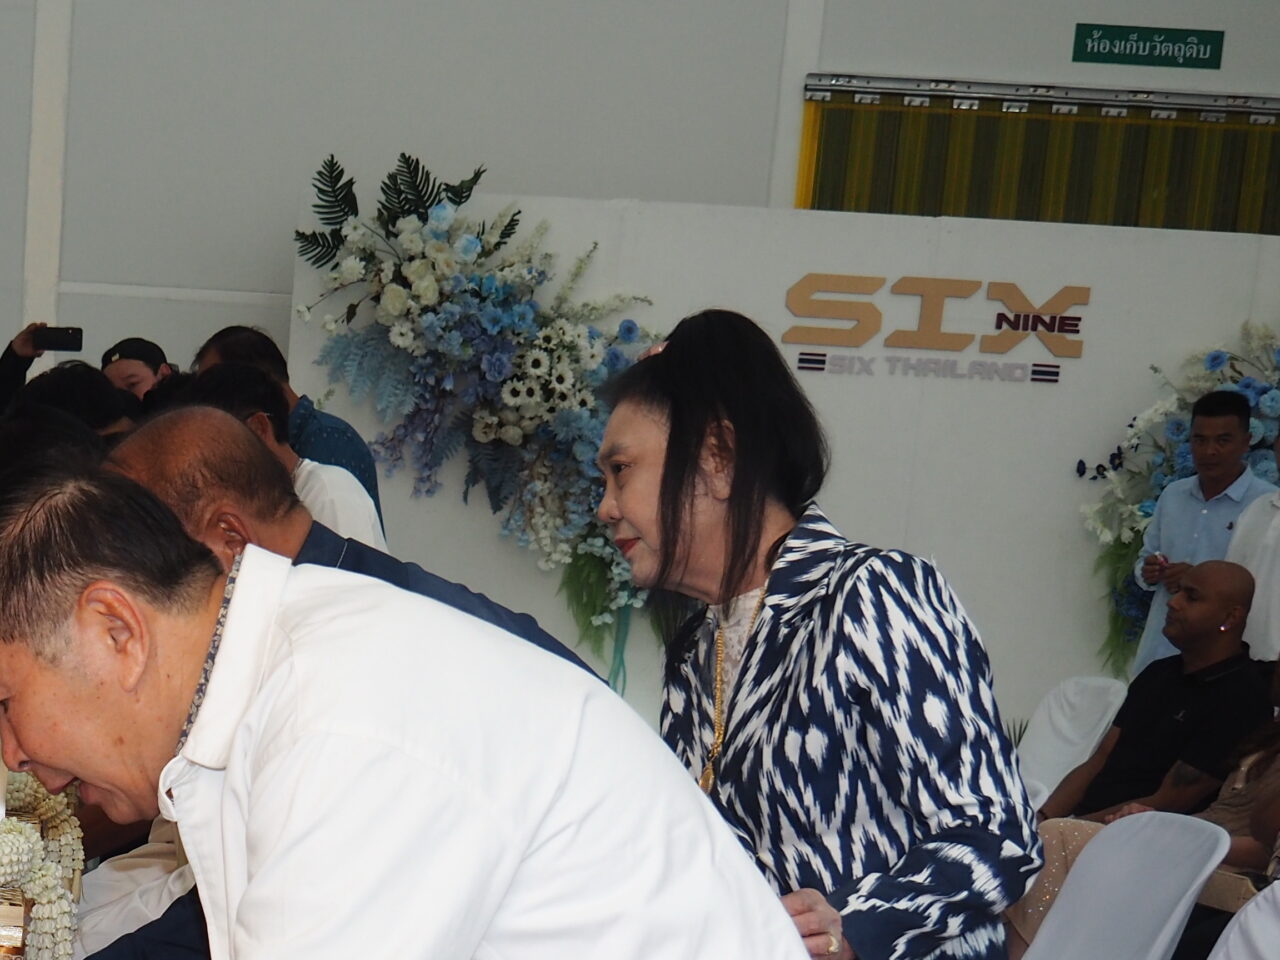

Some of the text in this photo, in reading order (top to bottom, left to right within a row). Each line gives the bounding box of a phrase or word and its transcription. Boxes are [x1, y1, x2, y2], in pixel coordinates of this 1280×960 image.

[1085, 30, 1211, 64] ห้องเก็บวัตถุดิบ
[781, 272, 1092, 359] SIX
[995, 312, 1082, 335] NINE
[827, 354, 1029, 384] SIX THAILAND
